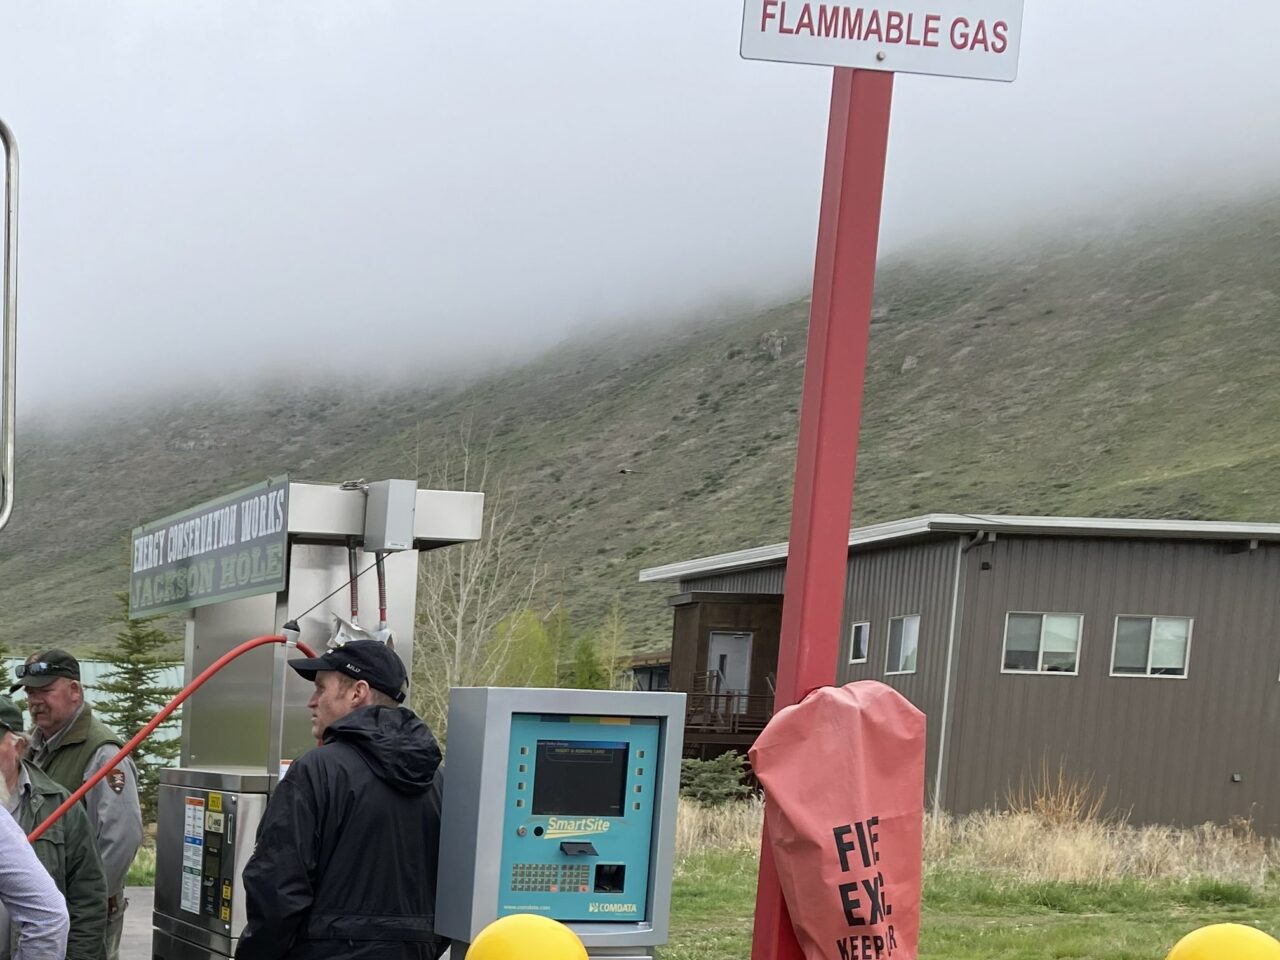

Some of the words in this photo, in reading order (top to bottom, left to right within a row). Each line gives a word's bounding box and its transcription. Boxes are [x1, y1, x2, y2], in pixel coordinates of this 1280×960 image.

[761, 0, 941, 47] FLAMMABLE
[950, 16, 1009, 54] GAS
[133, 529, 166, 573] ENERGY
[167, 504, 237, 563] CONSERVATION
[240, 489, 285, 542] WORKS
[132, 559, 216, 608] JACKSON
[220, 543, 283, 590] HOLE
[547, 817, 610, 831] SmartSite
[599, 903, 637, 913] COMDATA
